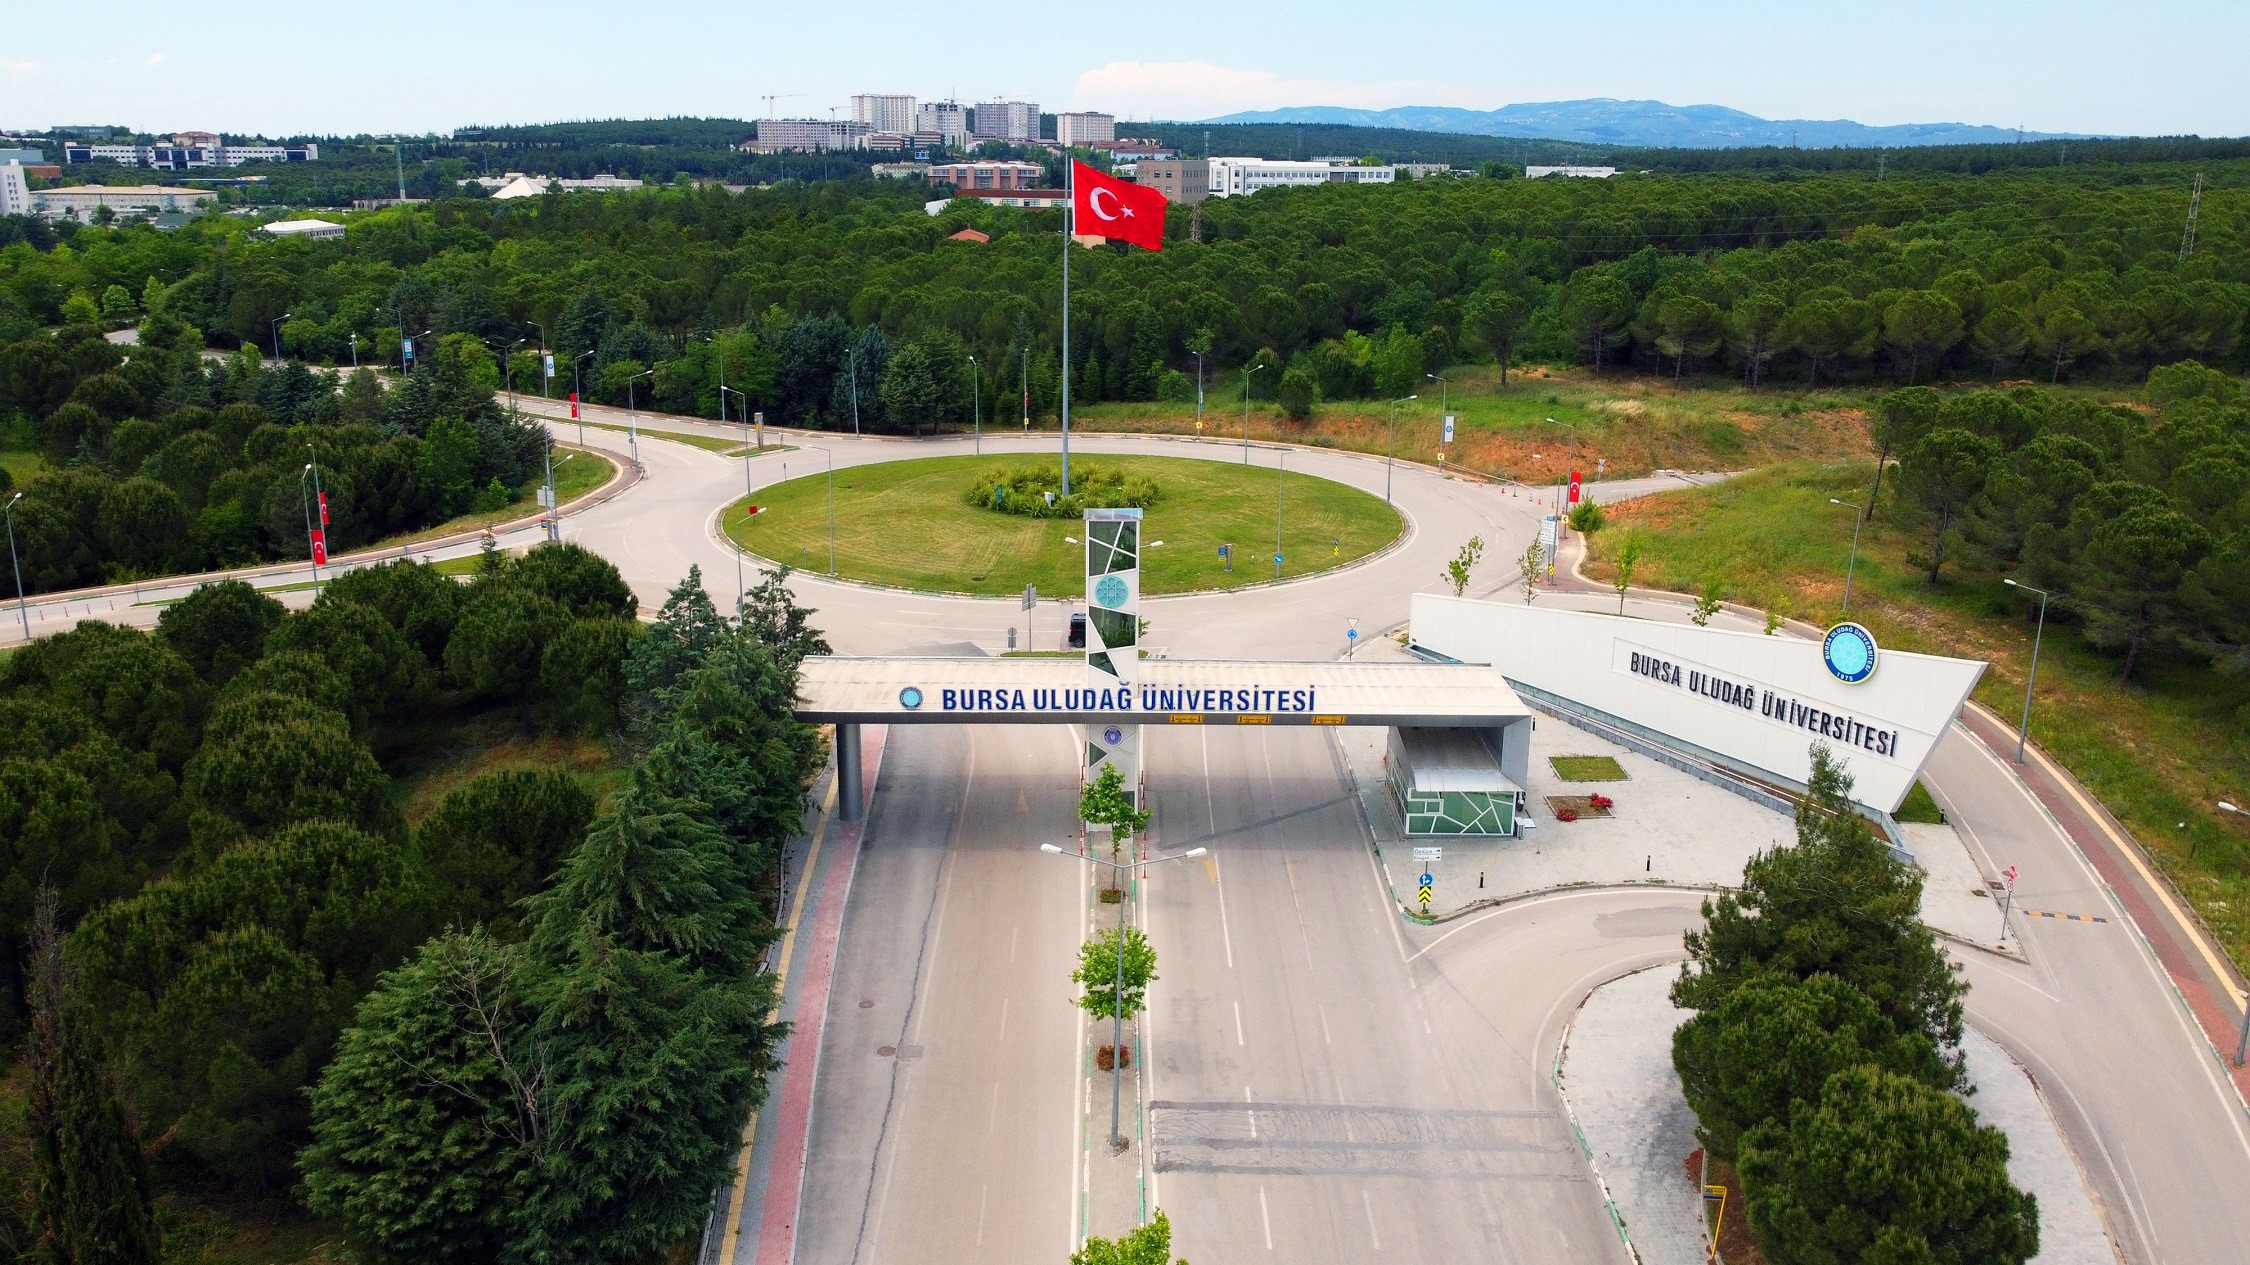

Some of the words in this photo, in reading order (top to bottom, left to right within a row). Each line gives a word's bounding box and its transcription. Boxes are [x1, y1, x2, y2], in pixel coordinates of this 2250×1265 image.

[1830, 626, 1854, 638] ULUDAĞ
[1836, 672, 1854, 682] 1975
[942, 689, 1026, 710] BURSA
[1033, 680, 1132, 710] ULUDAĞ
[1142, 683, 1316, 711] ÜNİVERSİTESİ
[1630, 651, 1681, 687] BURSA
[1689, 670, 1754, 710] ULUDAĞ
[1761, 690, 1898, 757] ÜNİVERSİTESİ
